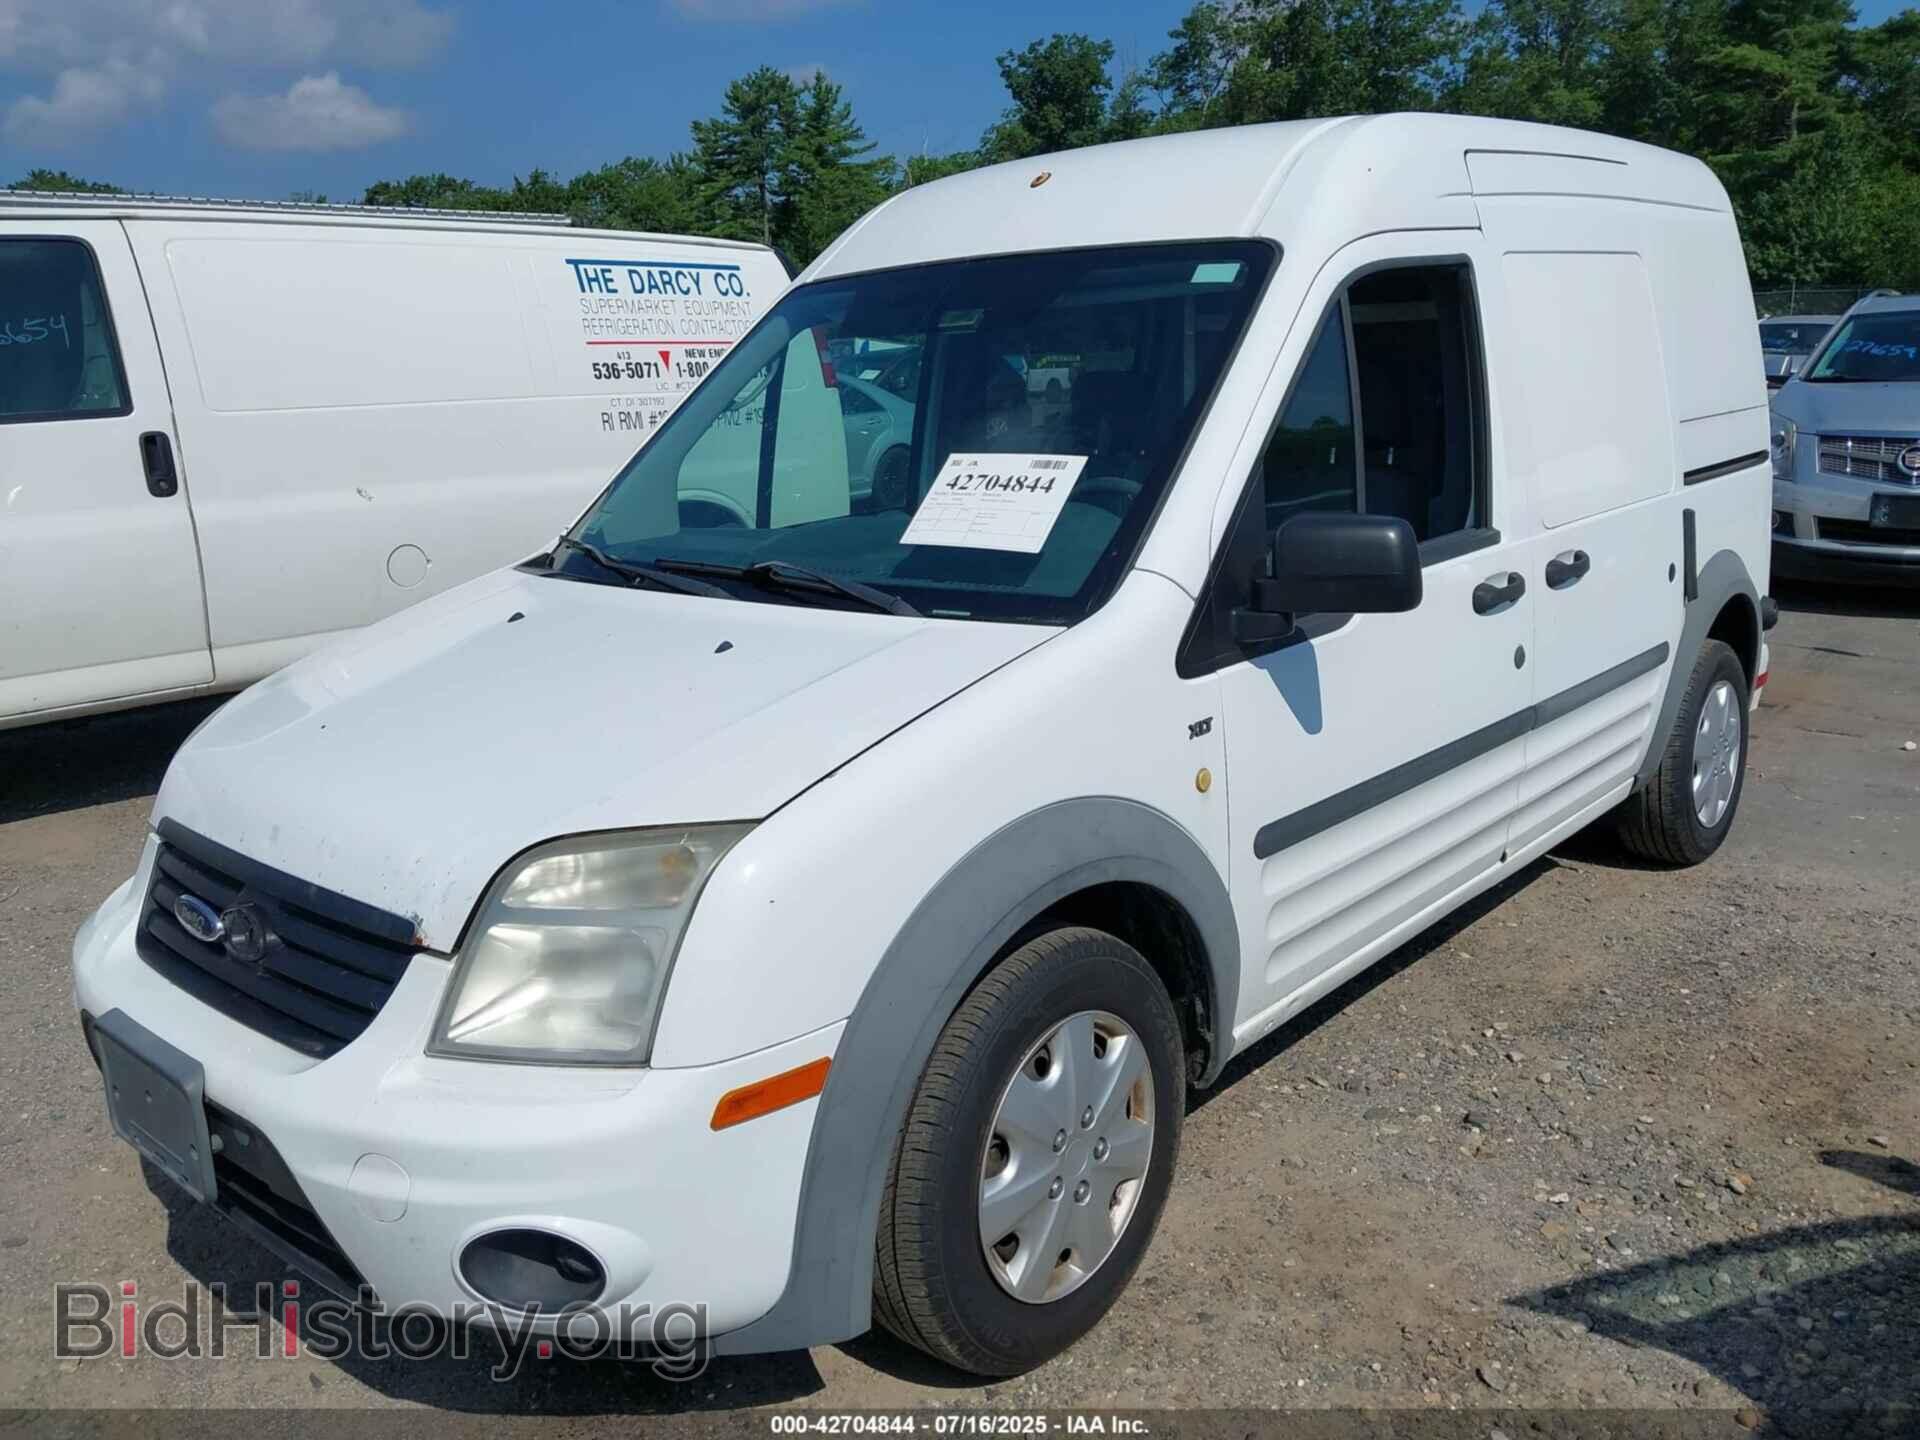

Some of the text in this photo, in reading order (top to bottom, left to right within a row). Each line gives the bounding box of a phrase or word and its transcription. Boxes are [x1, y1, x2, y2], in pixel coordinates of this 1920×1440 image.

[567, 259, 751, 297] THE DARCY CO.
[580, 298, 752, 317] SUPERMARKET EQUIPMENT
[582, 318, 676, 336] REFRIGERATION
[684, 348, 706, 359] NEW
[592, 362, 661, 380] 536-5071
[946, 474, 1056, 494] 42704844
[1188, 716, 1213, 740] XLT
